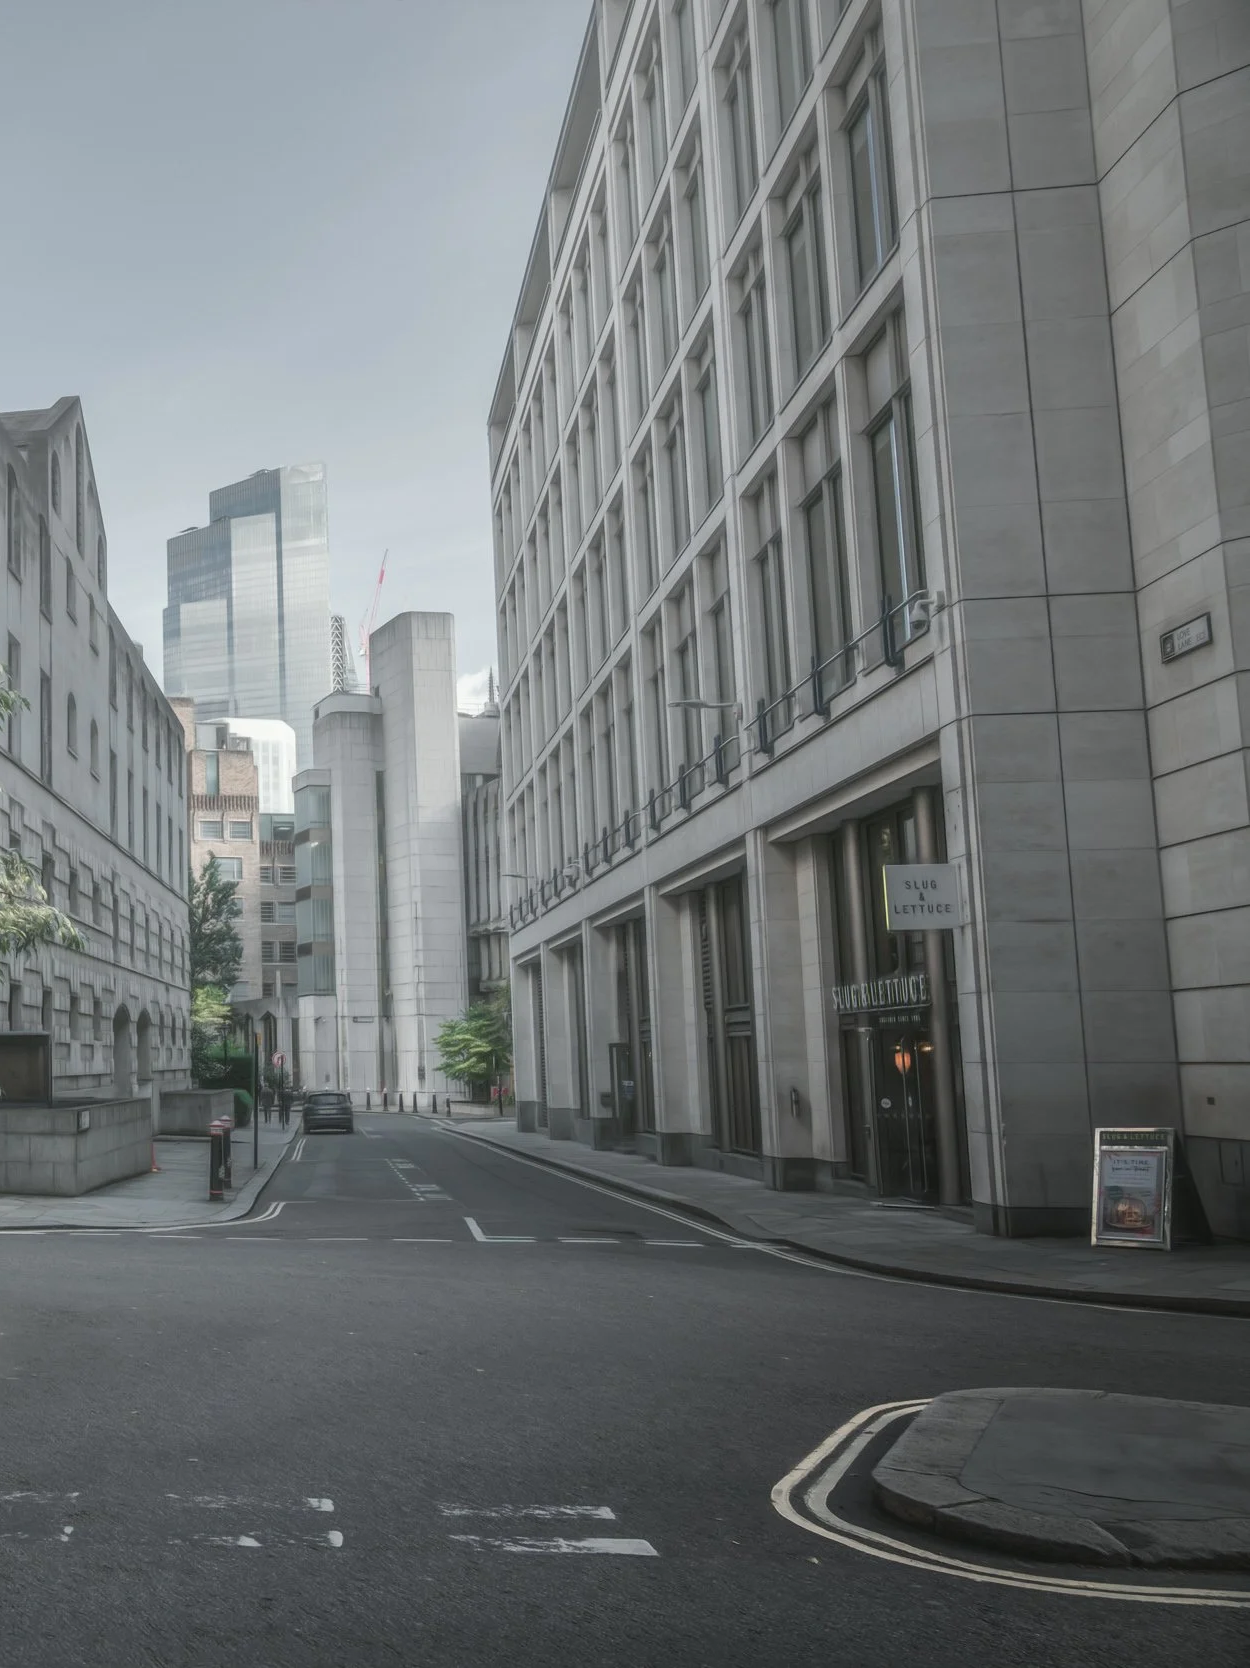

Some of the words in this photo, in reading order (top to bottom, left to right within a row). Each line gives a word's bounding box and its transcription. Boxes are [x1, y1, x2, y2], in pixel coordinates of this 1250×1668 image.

[905, 880, 938, 890] SLUG
[918, 892, 926, 902] &
[894, 903, 952, 914] LETTUCE
[831, 985, 858, 1011] SLUG
[860, 983, 869, 1007] &
[870, 974, 927, 1006] LETTUCE
